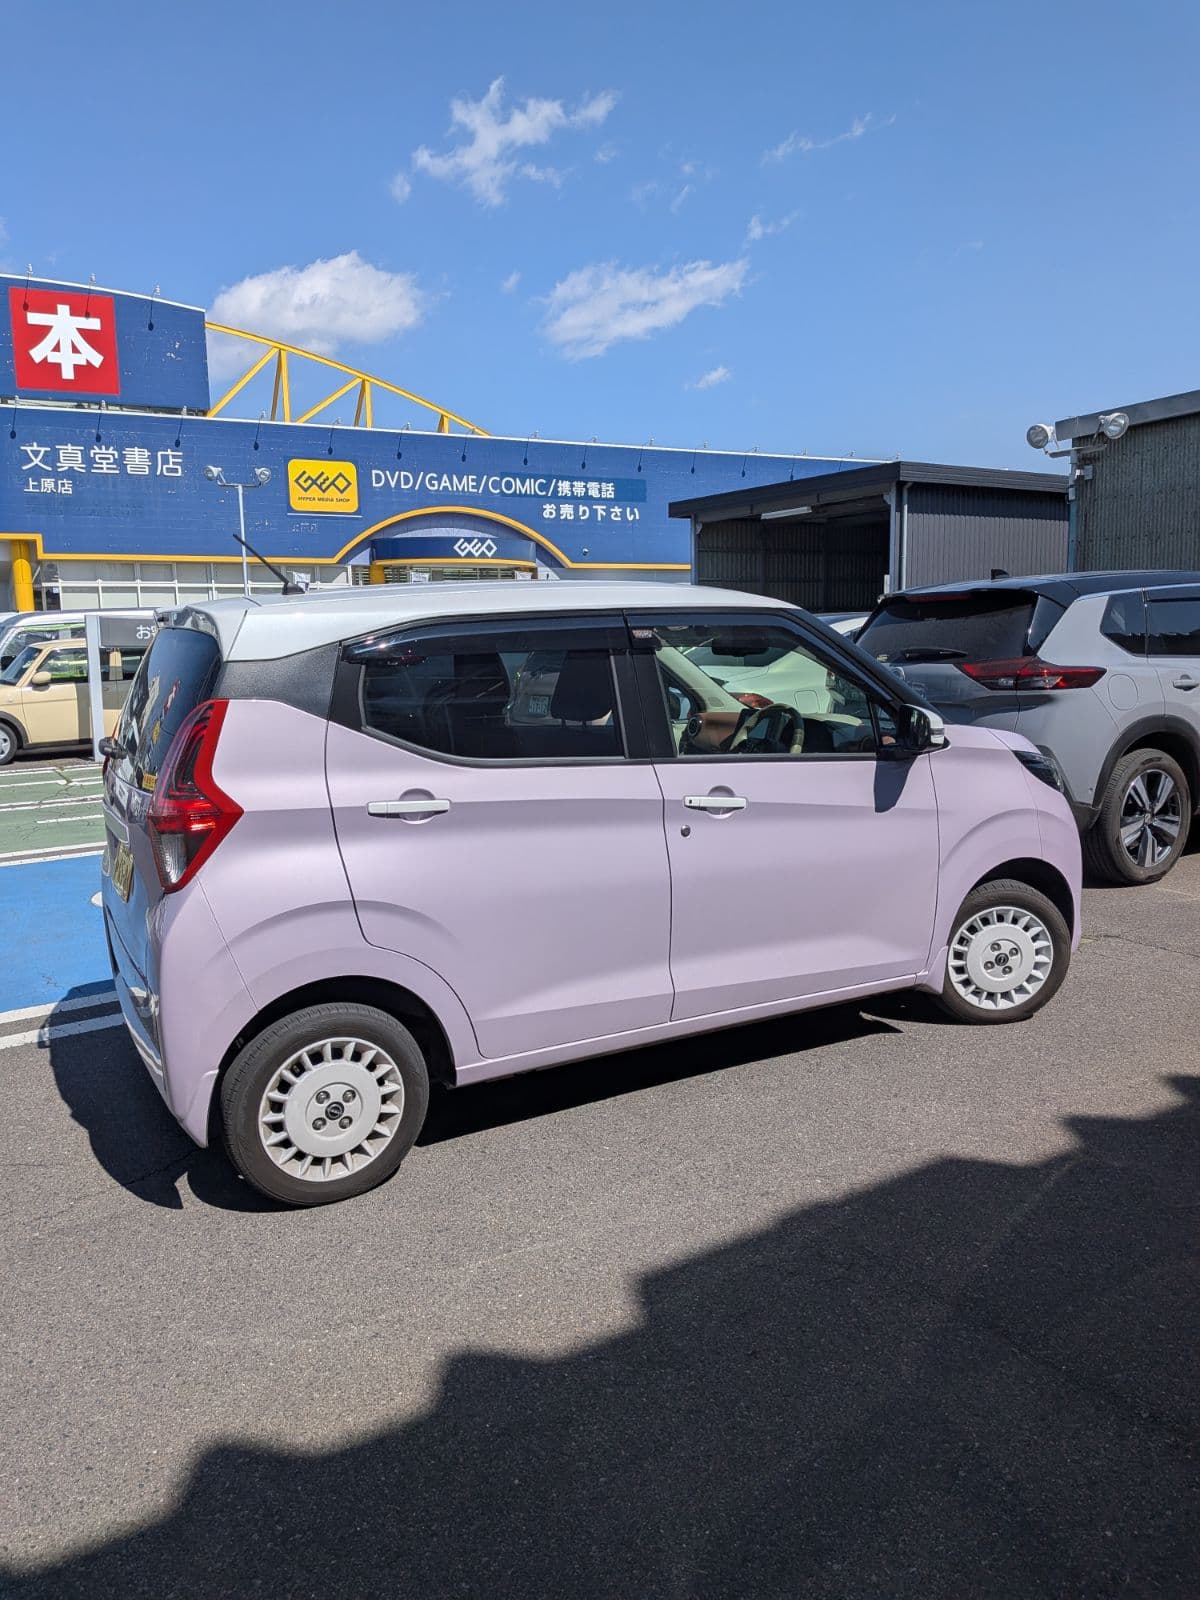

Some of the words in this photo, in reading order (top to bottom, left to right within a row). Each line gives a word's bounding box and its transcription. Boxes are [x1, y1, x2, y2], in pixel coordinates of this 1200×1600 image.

[26, 304, 104, 380] 本
[20, 442, 184, 477] 文真堂書店
[24, 477, 73, 494] 上原店
[294, 470, 352, 494] GEO
[371, 469, 615, 499] DVD/GAME/COMIC/携帯電話
[542, 503, 640, 521] お売り下さい
[453, 538, 498, 558] GEO
